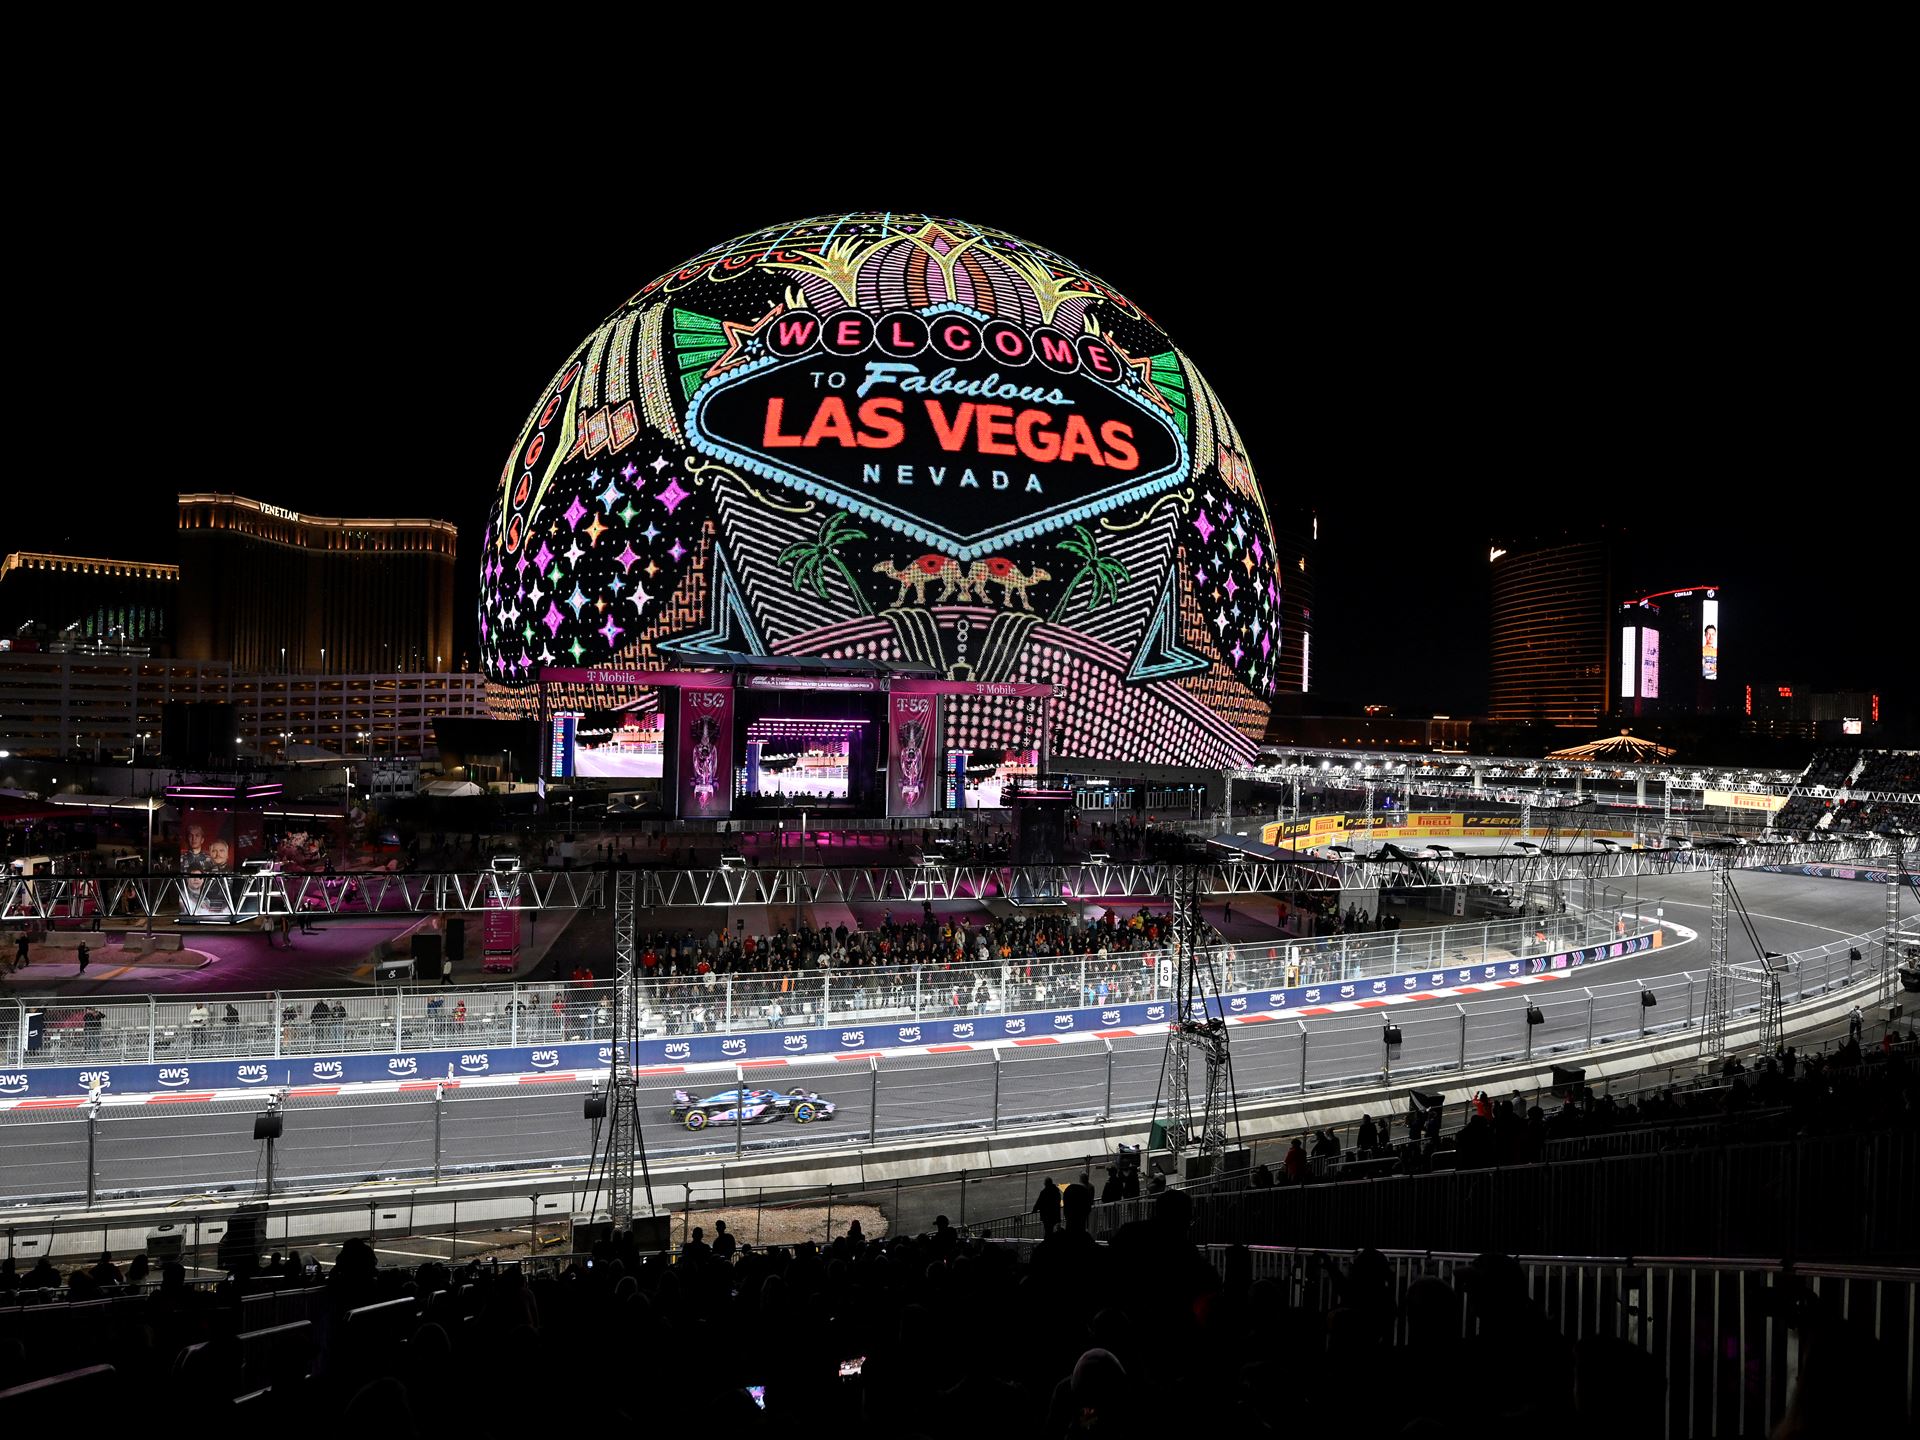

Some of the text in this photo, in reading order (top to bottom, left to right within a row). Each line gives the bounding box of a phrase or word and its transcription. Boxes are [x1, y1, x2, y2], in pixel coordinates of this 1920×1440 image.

[779, 319, 1111, 372] WELCOME
[811, 361, 1075, 405] TO Fabulous
[763, 396, 1140, 470] LAS VEGAS
[863, 462, 1044, 494] NEVADA
[260, 502, 299, 521] VENETIAN
[599, 671, 636, 682] Mobile
[986, 684, 1017, 694] Mobile
[703, 692, 725, 708] 5G
[909, 699, 929, 713] 5G
[1316, 819, 1333, 831] PIRELLI
[1418, 816, 1451, 826] PIRELLI
[1285, 826, 1290, 834] P
[1270, 993, 1285, 1002] aws
[1306, 988, 1320, 997] aws
[1231, 997, 1247, 1006] aws
[1102, 1010, 1120, 1019] aws
[1147, 1005, 1164, 1015] aws
[1006, 1018, 1025, 1028] aws
[1054, 1014, 1073, 1024] aws
[899, 1026, 920, 1037] aws
[953, 1022, 974, 1033] aws
[784, 1034, 807, 1045] aws
[842, 1030, 864, 1041] aws
[665, 1042, 690, 1053] aws
[722, 1038, 746, 1049] aws
[461, 1053, 488, 1064] aws
[532, 1050, 558, 1061] aws
[313, 1061, 342, 1072] aws
[388, 1057, 417, 1068] aws
[158, 1067, 189, 1079] aws
[238, 1064, 267, 1076] aws
[79, 1070, 110, 1082] aws
